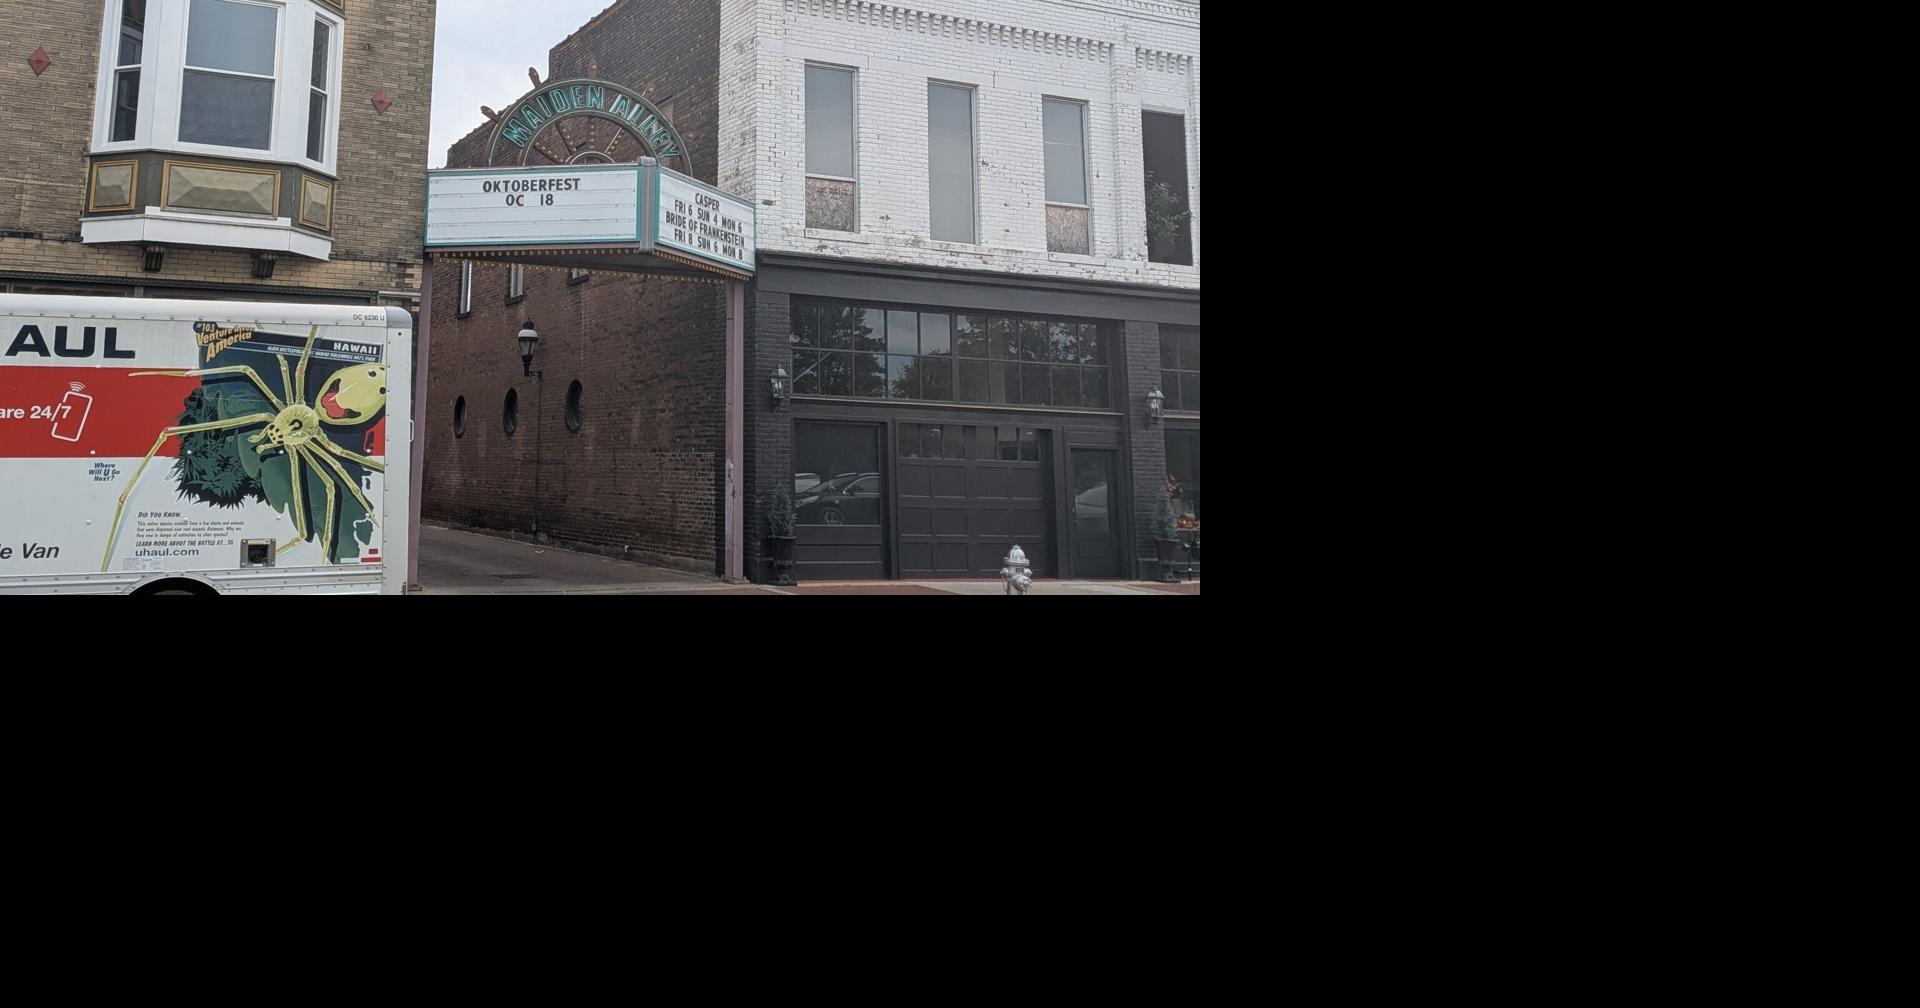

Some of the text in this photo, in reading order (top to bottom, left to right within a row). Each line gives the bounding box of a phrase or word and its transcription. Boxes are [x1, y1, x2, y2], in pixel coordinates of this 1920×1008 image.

[502, 85, 681, 158] MAIDEN ALLEY
[482, 178, 581, 192] OKTOBERFEST
[506, 194, 554, 206] OC 18
[695, 192, 720, 212] CASPER
[674, 200, 742, 234] FRI 6 SUN 4 MON 6
[666, 211, 744, 248] BRIDE OF FRANKENSTEIN
[674, 228, 743, 260] FRI 8 SUN 6 MON 8
[5, 324, 136, 358] AUL
[196, 329, 233, 345] Venture
[206, 331, 252, 364] America
[334, 342, 376, 354] HAWAII
[30, 402, 72, 421] 24/7
[0, 543, 60, 560] e Van
[136, 548, 199, 556] uhaul.com
